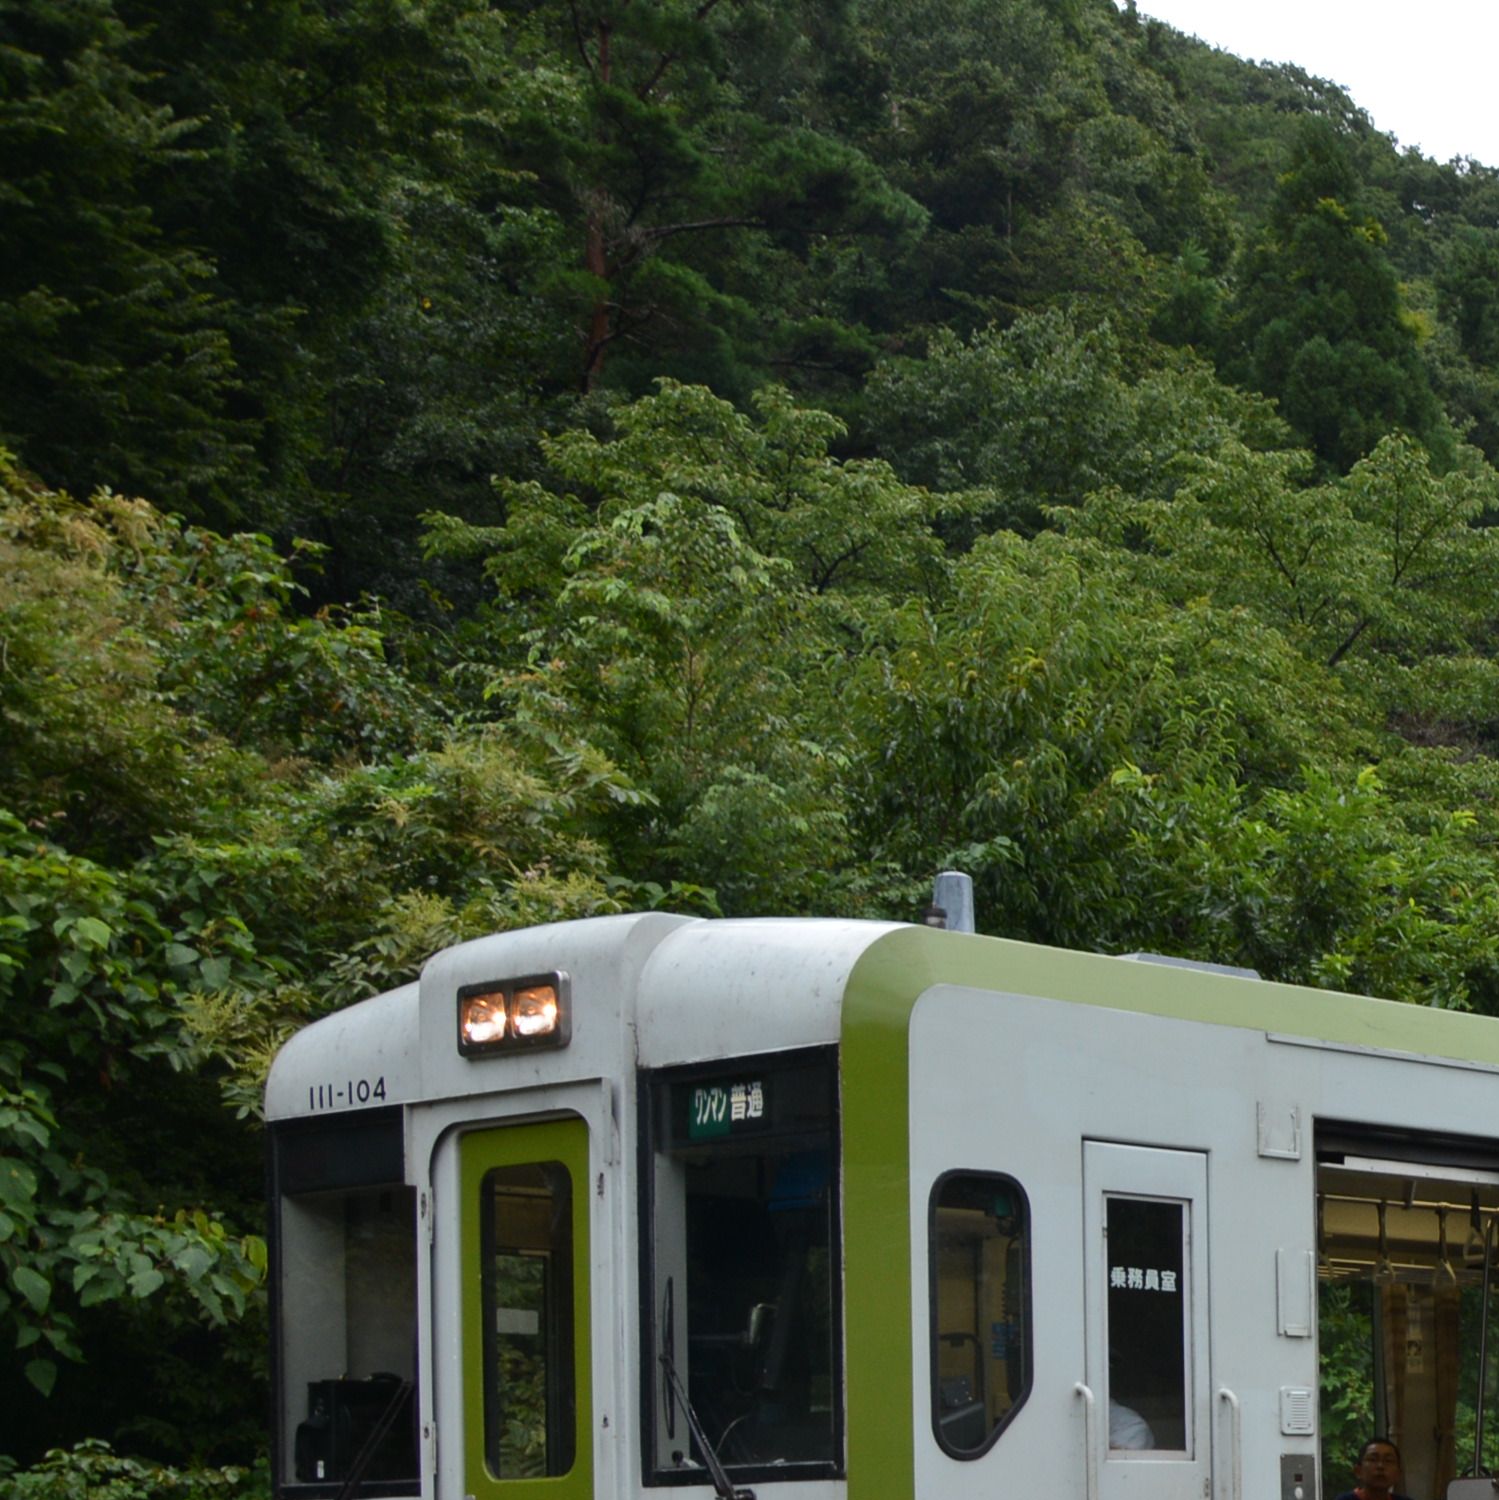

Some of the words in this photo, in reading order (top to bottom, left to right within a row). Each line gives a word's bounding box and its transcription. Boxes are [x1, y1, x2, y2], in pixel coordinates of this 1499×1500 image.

[309, 1076, 386, 1110] 111-104
[694, 1086, 727, 1126] ワンマン
[730, 1081, 763, 1121] 普通
[1110, 1266, 1177, 1292] 乗務員室
